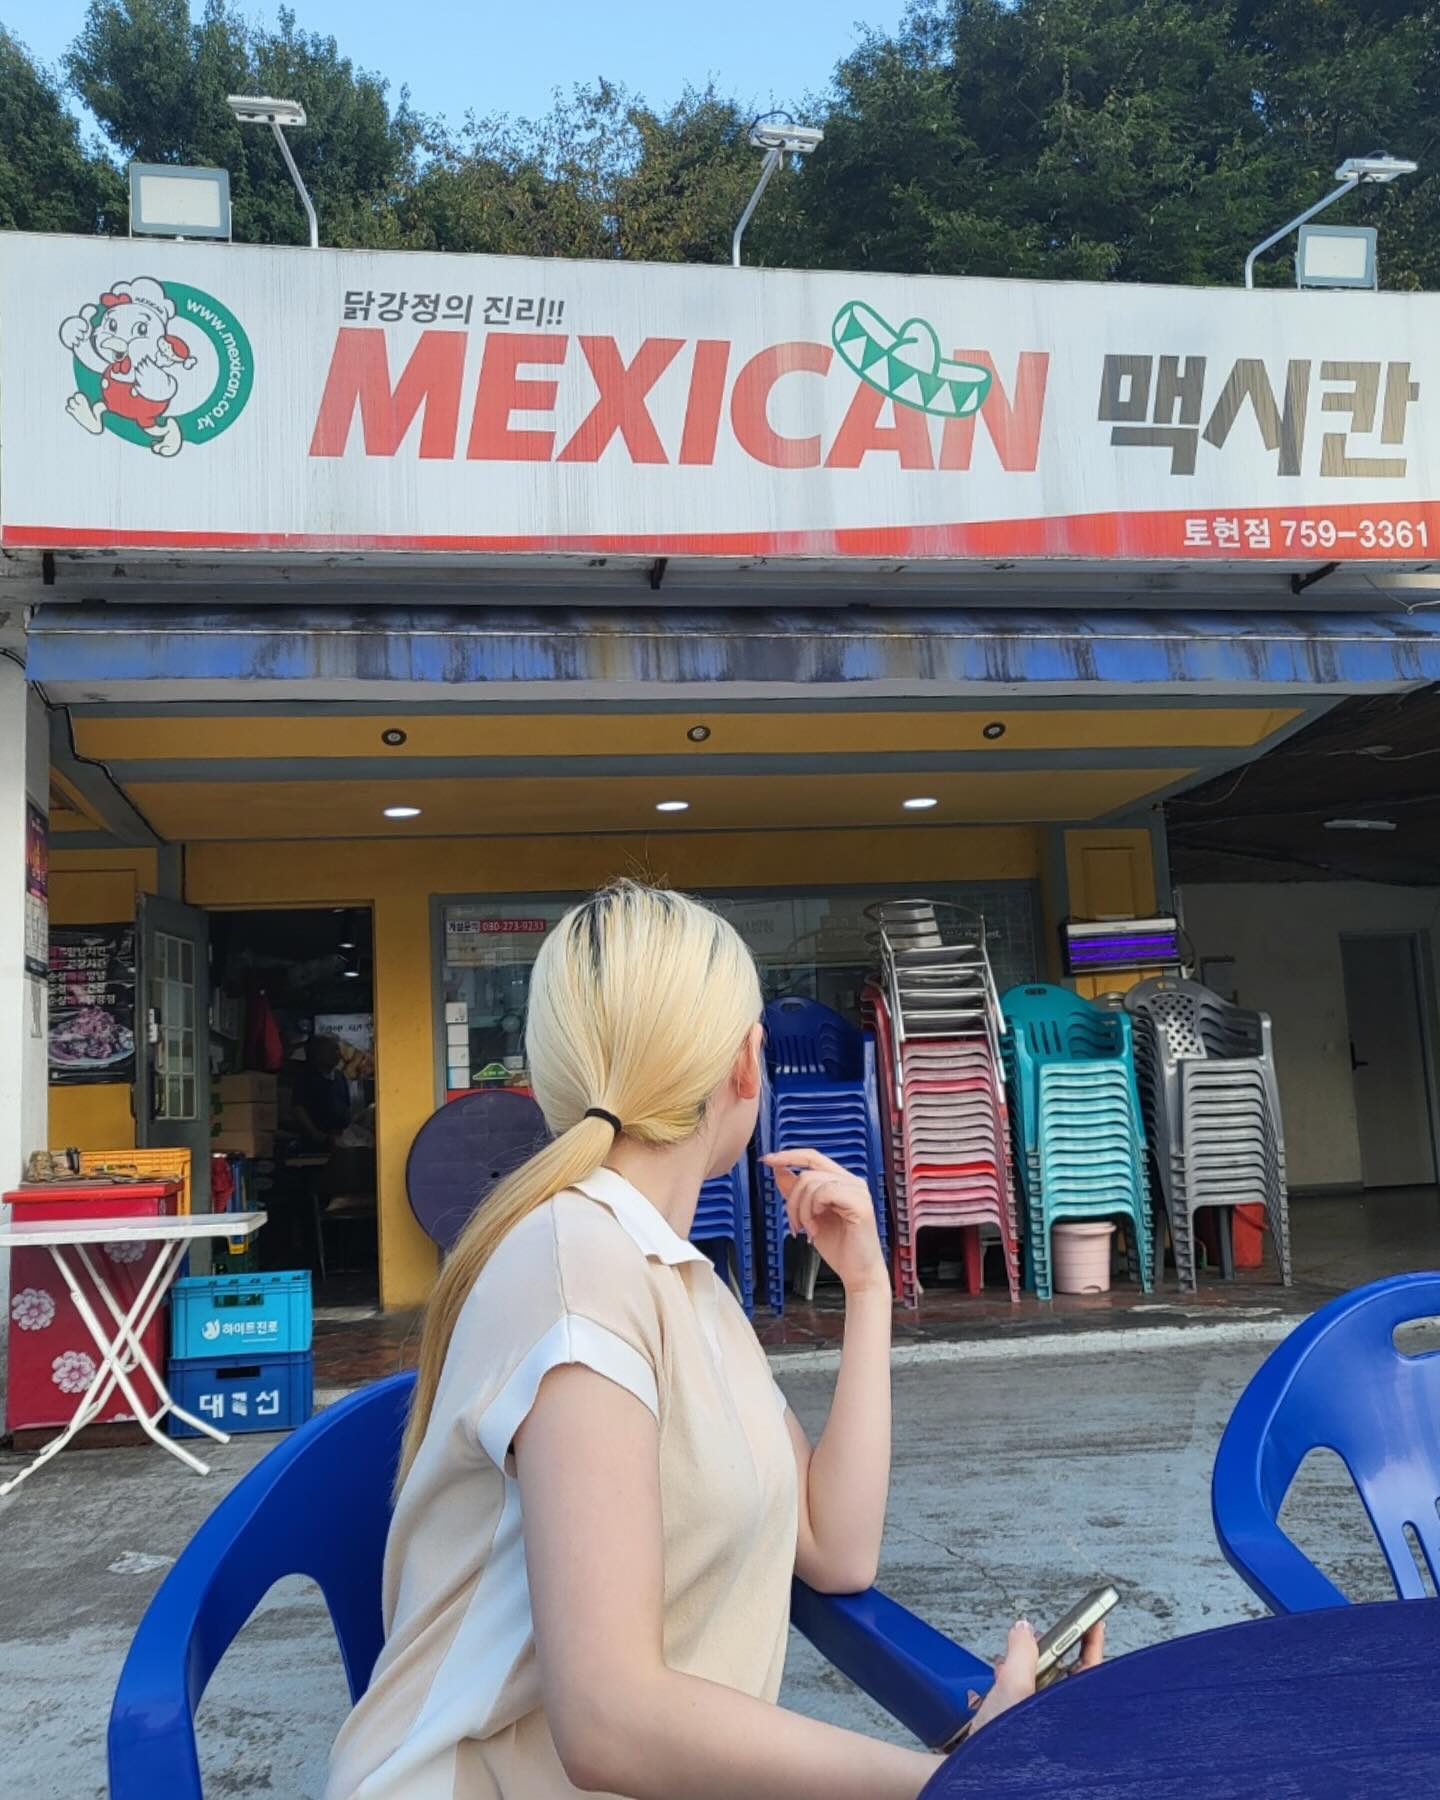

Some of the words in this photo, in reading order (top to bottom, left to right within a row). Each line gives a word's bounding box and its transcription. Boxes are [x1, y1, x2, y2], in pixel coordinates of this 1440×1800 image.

[343, 291, 473, 325] 닭강정의
[483, 296, 565, 327] 진리!!
[186, 299, 245, 430] www.mexican.co.kr
[309, 326, 1050, 472] MEXICAN
[1098, 354, 1420, 478] 맥시칸
[1183, 517, 1271, 549] 토현점
[1280, 519, 1428, 548] 759-3361
[221, 1320, 279, 1337] 하이트진로
